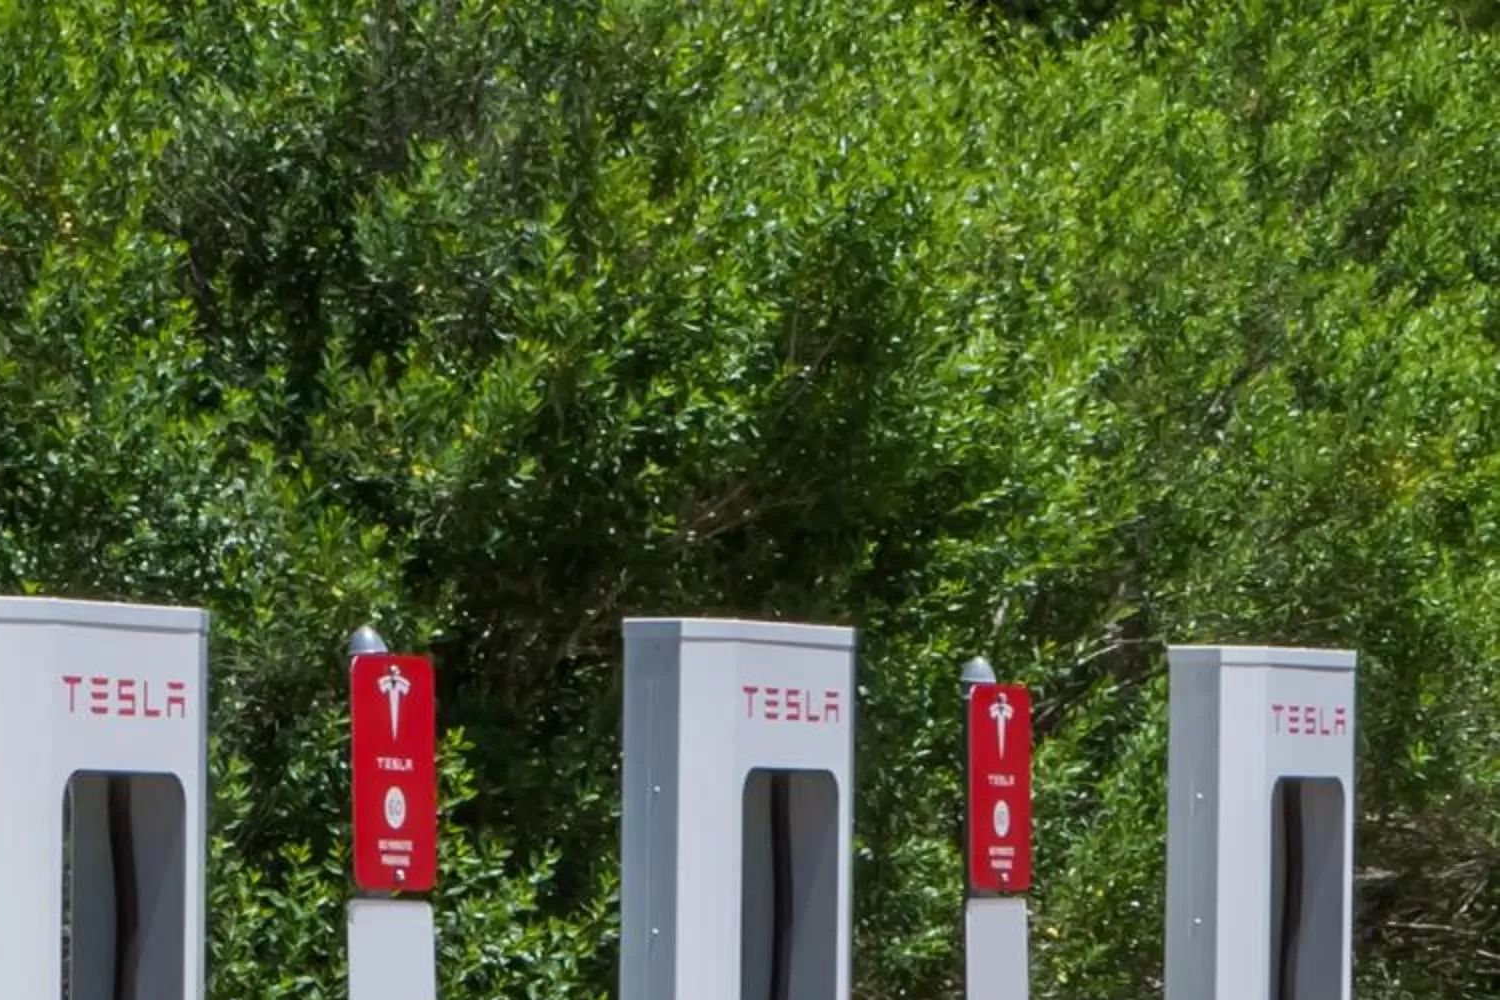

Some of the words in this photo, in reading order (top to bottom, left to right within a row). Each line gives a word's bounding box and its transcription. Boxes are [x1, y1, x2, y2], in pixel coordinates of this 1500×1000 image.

[62, 675, 186, 719] TESLA
[742, 685, 840, 724] TESLA
[1271, 704, 1346, 736] TESLA
[376, 757, 414, 771] TESLA
